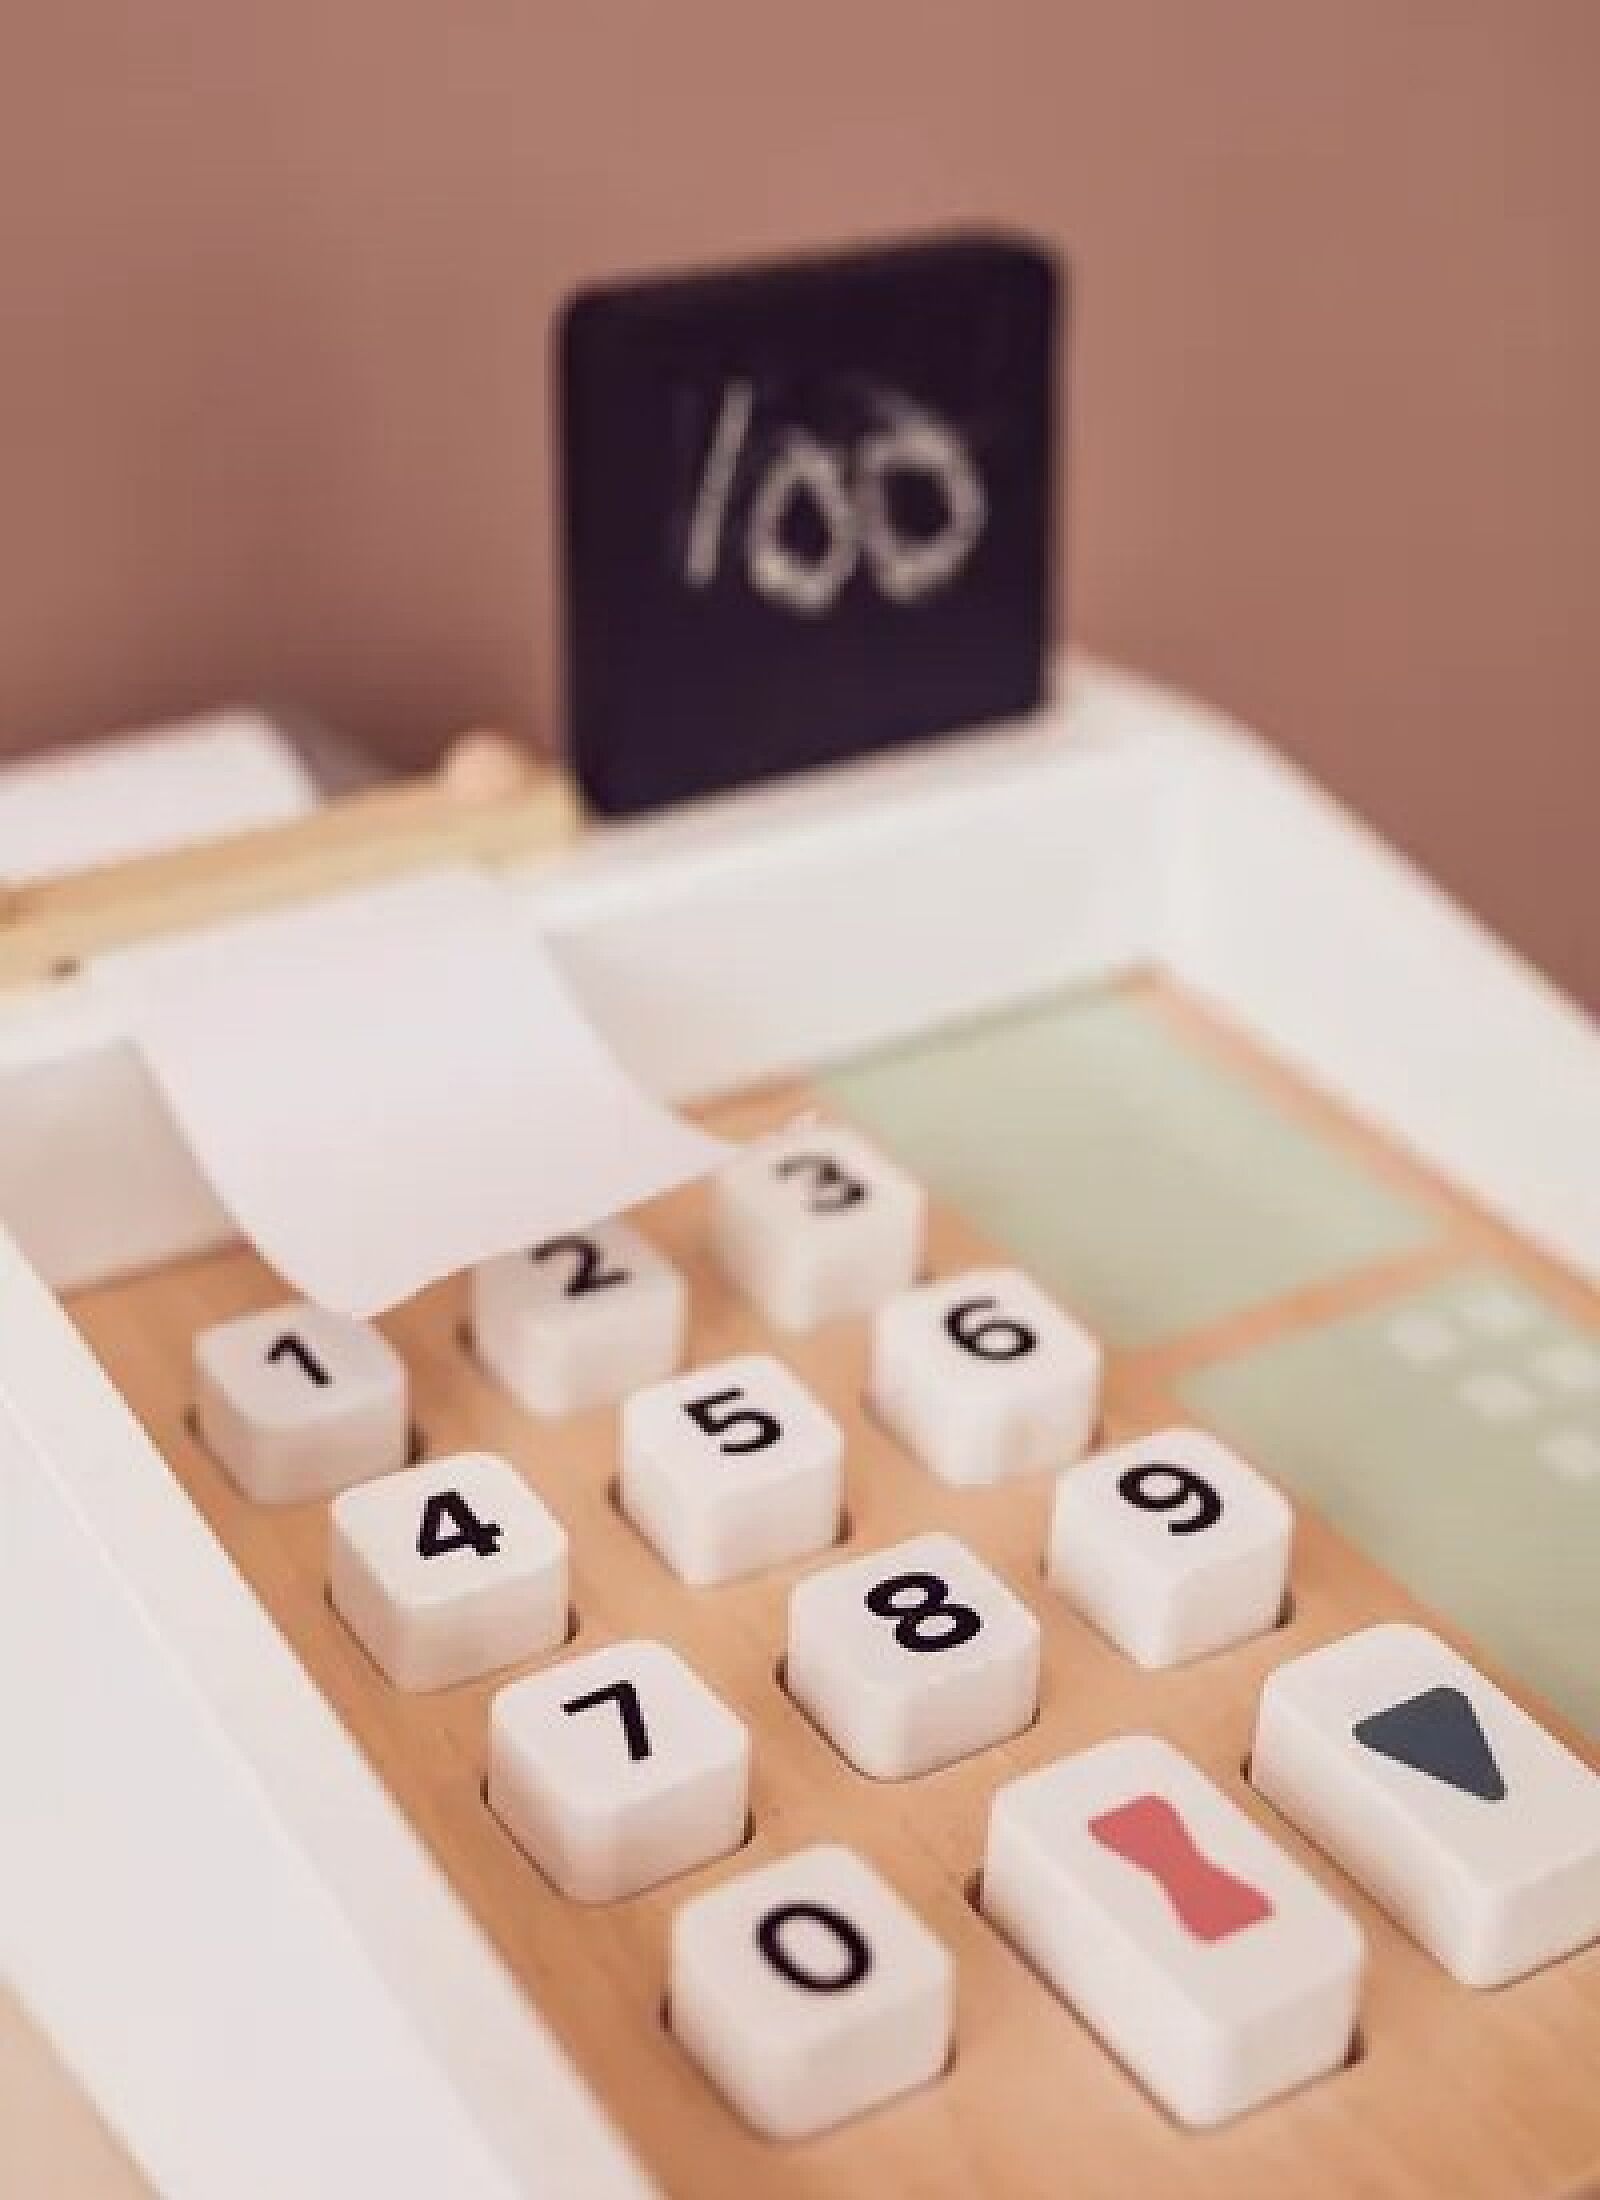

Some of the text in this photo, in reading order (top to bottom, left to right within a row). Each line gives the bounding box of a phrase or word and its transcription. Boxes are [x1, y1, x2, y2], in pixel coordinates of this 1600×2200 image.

[686, 380, 986, 616] 100
[772, 1154, 868, 1214] 3
[530, 1235, 628, 1296] 2
[267, 1333, 331, 1387] 1
[944, 1300, 1036, 1360] 6
[683, 1389, 782, 1455] 5
[417, 1491, 503, 1558] 4
[1118, 1465, 1223, 1535] 9
[865, 1573, 982, 1652] 8
[562, 1681, 652, 1760] 7
[756, 1903, 872, 1994] 0
